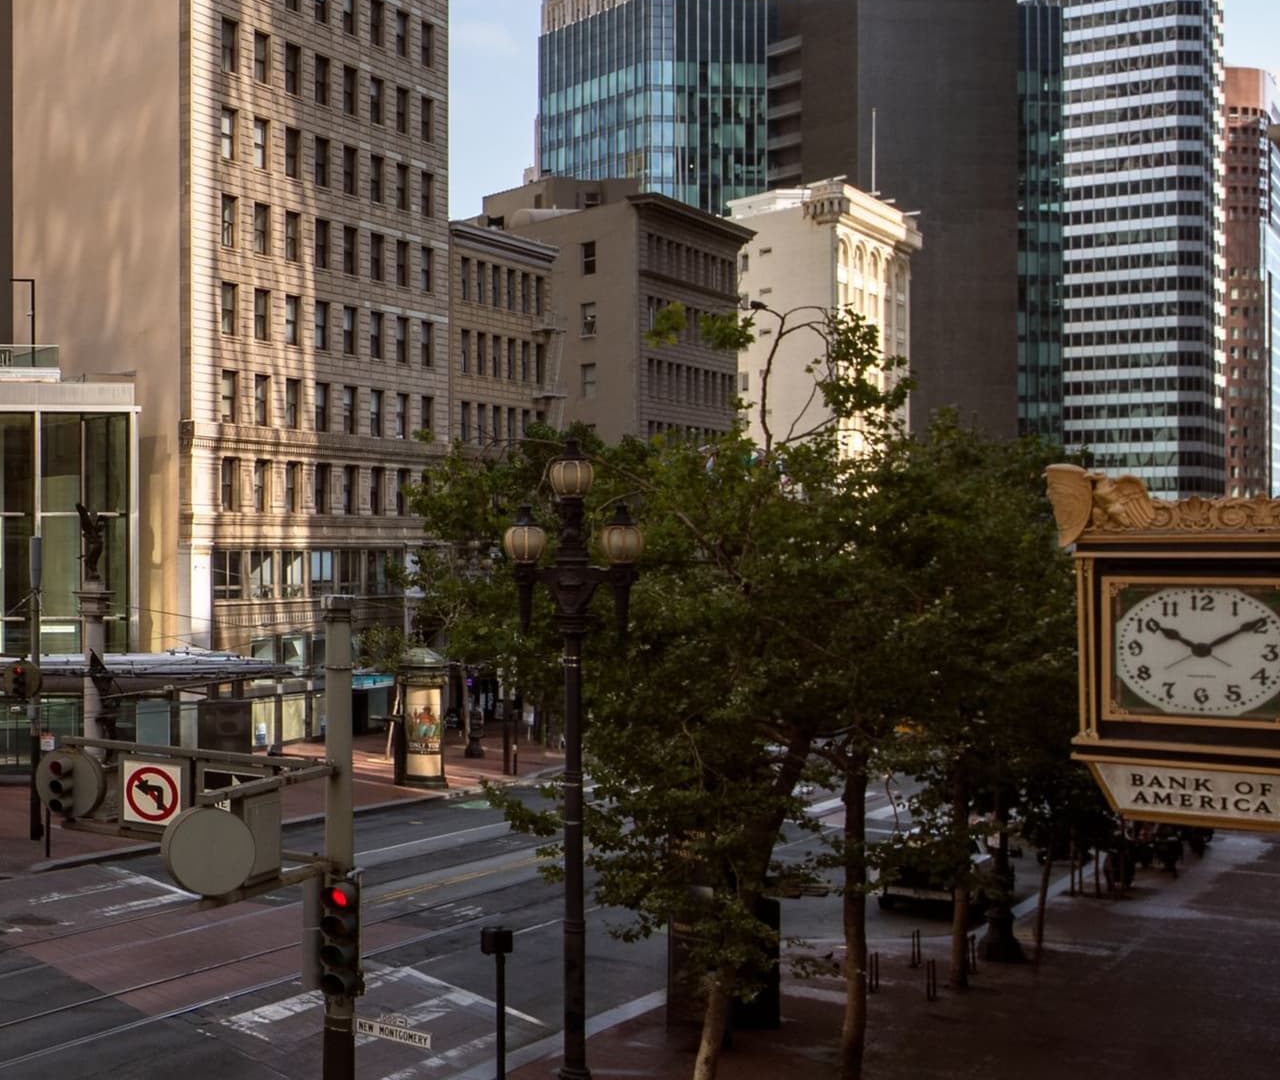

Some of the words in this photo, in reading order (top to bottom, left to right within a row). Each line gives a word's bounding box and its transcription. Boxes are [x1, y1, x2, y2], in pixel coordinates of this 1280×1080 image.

[1162, 601, 1178, 618] 11
[1190, 594, 1215, 612] 12
[1232, 600, 1239, 617] 1
[1136, 618, 1160, 633] 10
[1128, 640, 1143, 656] 9
[1261, 644, 1279, 661] 3
[1137, 665, 1152, 681] 8
[1250, 668, 1270, 685] 4
[1162, 682, 1176, 699] 7
[1194, 688, 1209, 704] 6
[1225, 684, 1241, 702] 5
[1130, 773, 1214, 792] BANK
[1235, 781, 1273, 796] OF
[1132, 790, 1273, 814] AMERICA
[358, 1020, 374, 1033] NEW
[378, 1025, 428, 1046] MONTGOMERY
